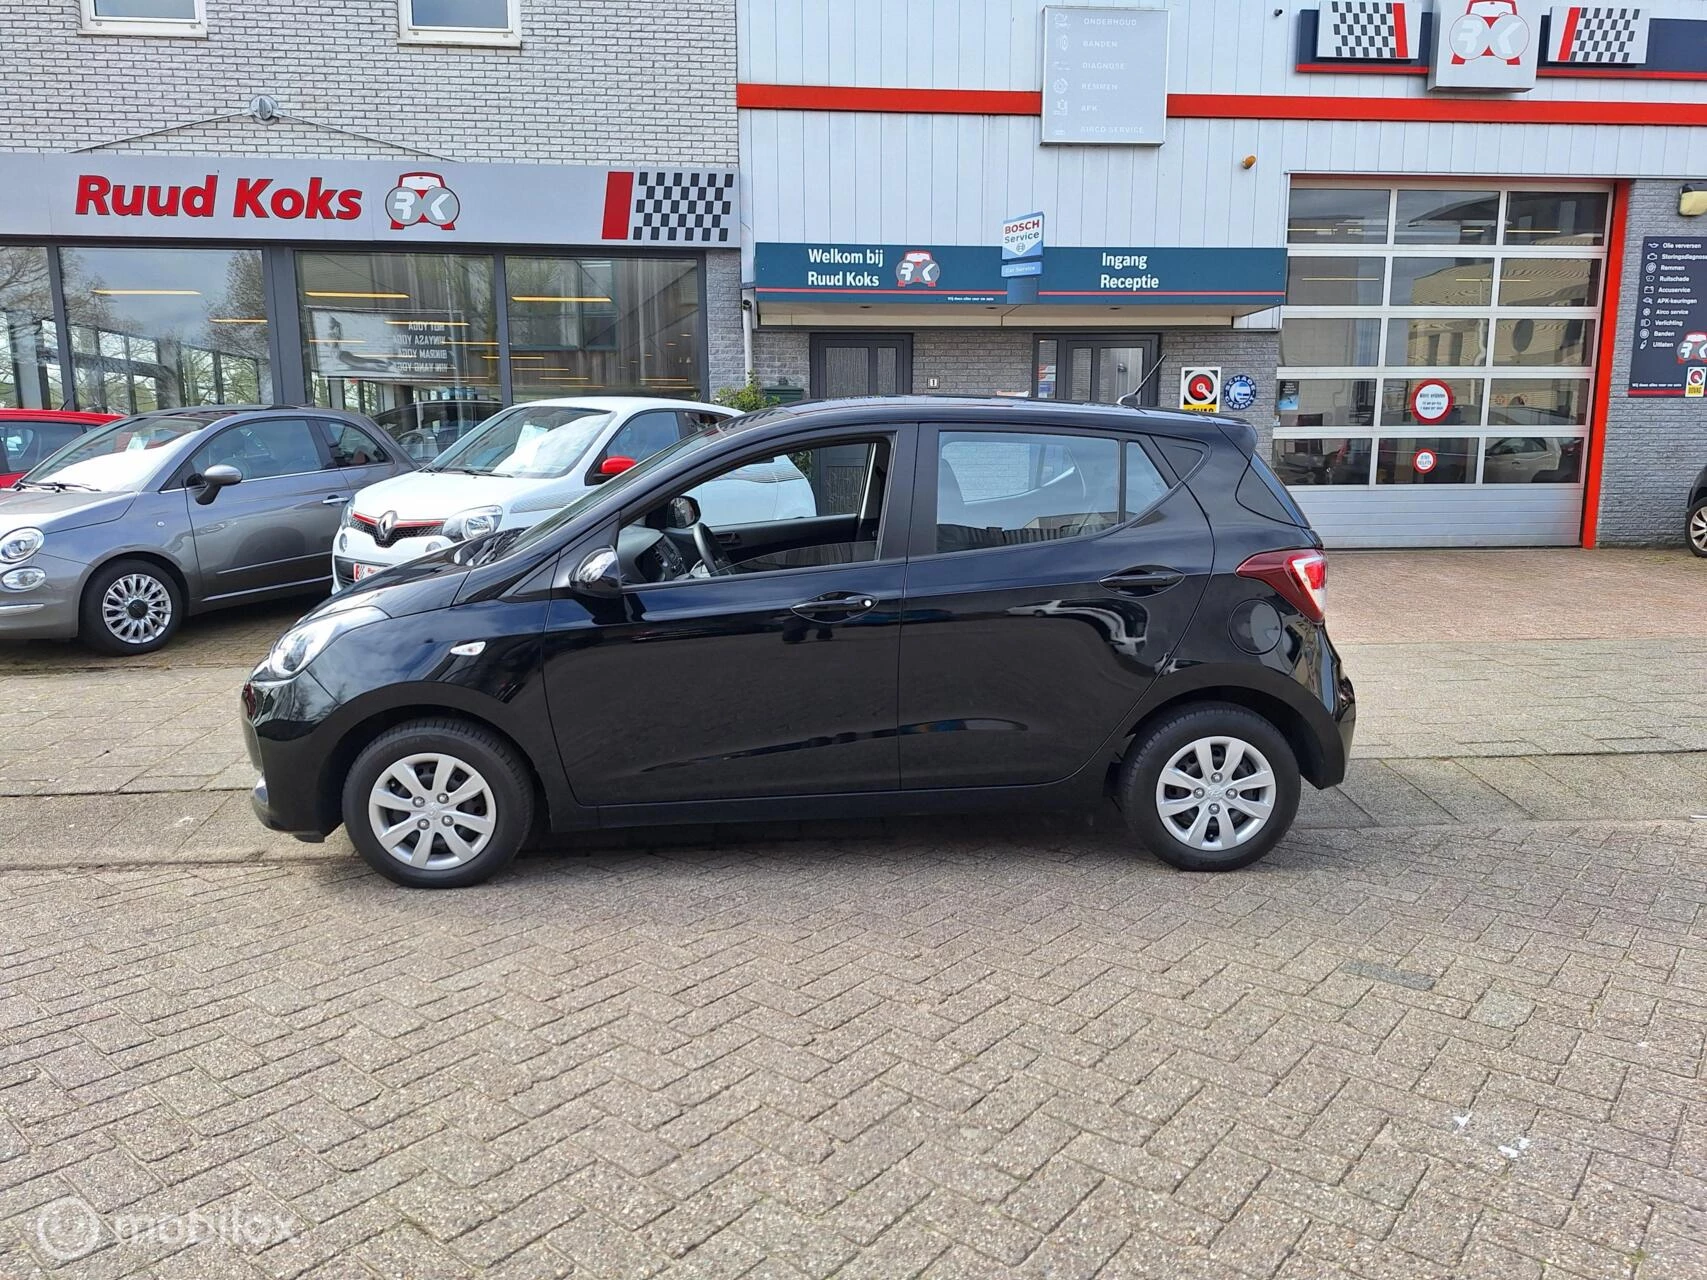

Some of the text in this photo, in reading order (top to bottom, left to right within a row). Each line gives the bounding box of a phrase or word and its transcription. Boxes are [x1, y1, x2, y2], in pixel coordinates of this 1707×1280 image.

[1083, 17, 1137, 26] ONDERHOUD
[1082, 40, 1118, 48] BANDEN
[1082, 62, 1125, 70] DIAGNOSE
[75, 174, 363, 220] Ruud Koks
[1004, 219, 1040, 235] BOSCH
[1004, 231, 1040, 244] Service
[808, 248, 884, 267] Welkom bij
[1101, 252, 1148, 270] Ingang
[807, 271, 880, 287] Ruud Koks
[1100, 274, 1159, 291] Receptie
[1225, 376, 1256, 391] SCHADE
